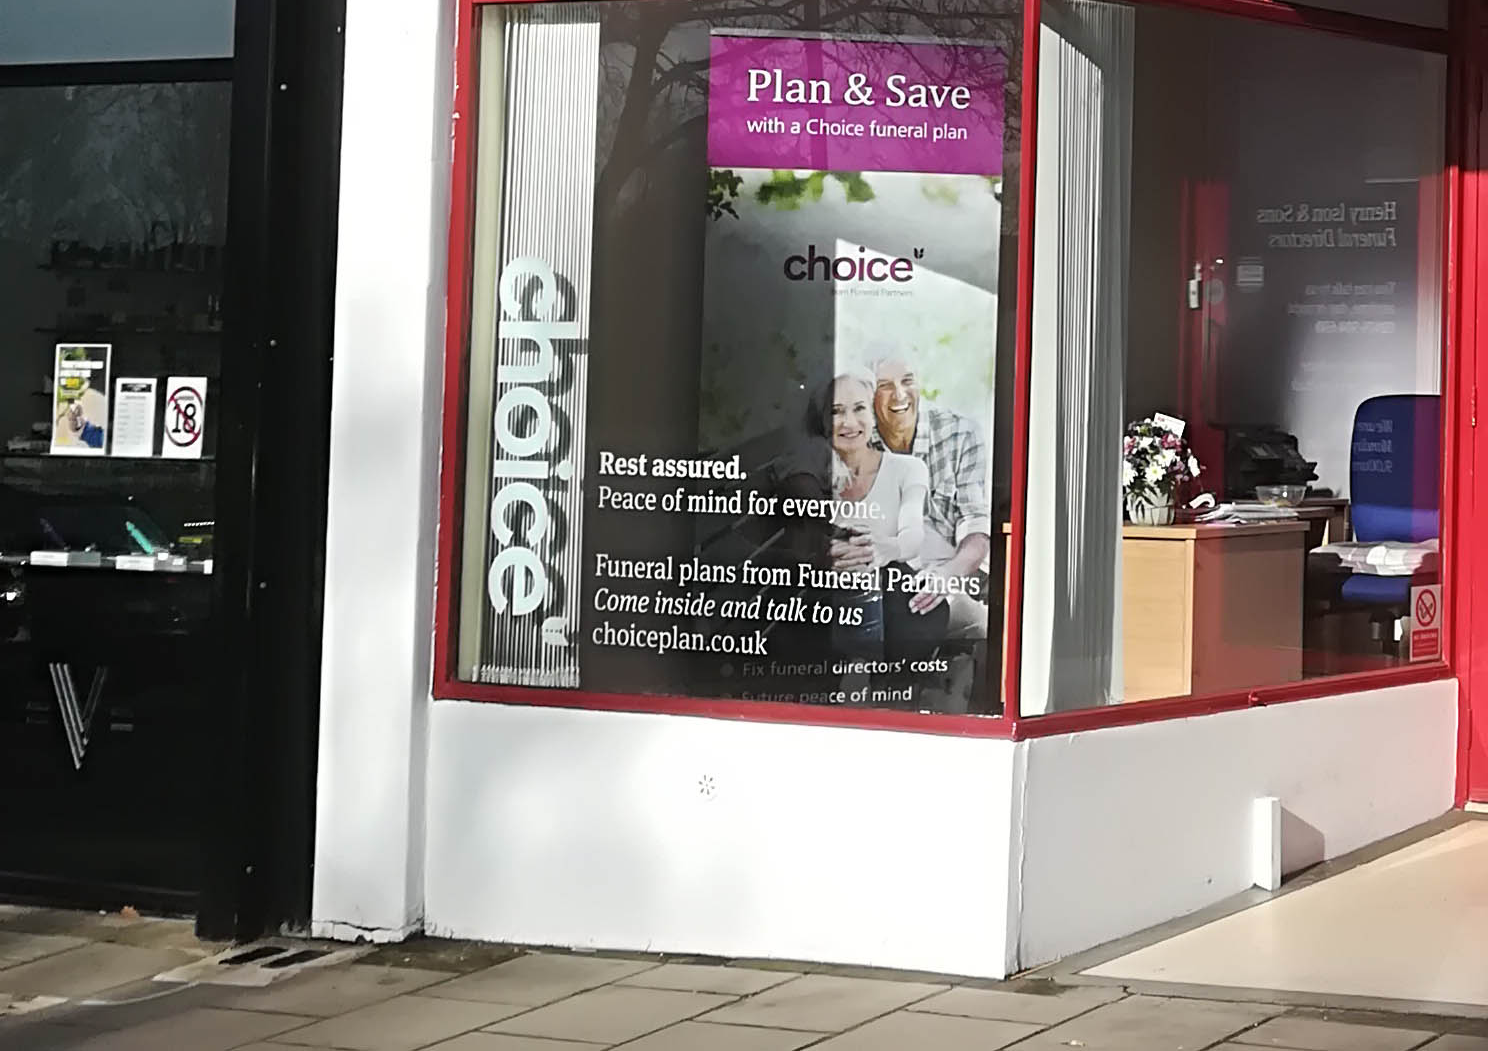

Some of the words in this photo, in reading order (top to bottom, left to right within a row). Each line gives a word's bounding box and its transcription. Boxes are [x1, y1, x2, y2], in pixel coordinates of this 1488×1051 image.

[747, 68, 832, 105] Plan
[844, 72, 875, 107] &
[885, 74, 972, 110] Save
[746, 116, 785, 134] with
[790, 120, 801, 134] a
[806, 118, 865, 137] Choice
[869, 119, 928, 140] funeral
[932, 122, 968, 143] plan
[783, 244, 914, 283] choice
[171, 402, 197, 434] 18
[486, 255, 583, 617] choice
[598, 451, 648, 477] Rest
[651, 454, 748, 481] assured.
[598, 485, 657, 511] Peace
[661, 487, 685, 512] of
[687, 489, 742, 515] mind
[747, 490, 778, 516] for
[782, 497, 887, 524] everyone.
[595, 552, 674, 582] Funeral
[678, 557, 738, 588] plans
[741, 560, 792, 587] from
[798, 562, 881, 592] Funeral
[886, 566, 982, 597] Partners
[593, 587, 650, 614] Come
[654, 590, 716, 618] inside
[720, 594, 762, 620] and
[766, 597, 808, 623] talk
[811, 601, 834, 625] to
[838, 606, 864, 626] us
[592, 621, 769, 655] choiceplan.co.uk
[743, 661, 765, 676] Fix
[770, 660, 828, 676] funeral
[910, 657, 949, 673] costs
[798, 689, 846, 704] peace
[849, 687, 868, 703] of
[872, 686, 914, 702] mind
